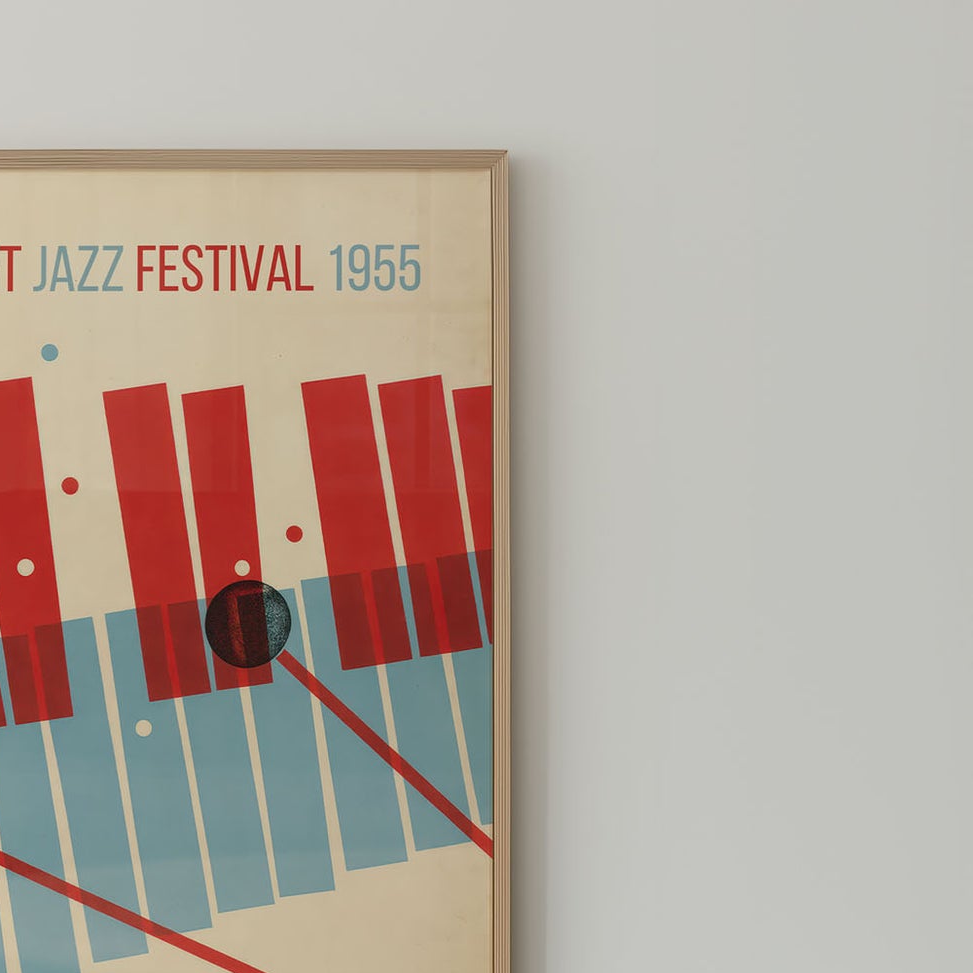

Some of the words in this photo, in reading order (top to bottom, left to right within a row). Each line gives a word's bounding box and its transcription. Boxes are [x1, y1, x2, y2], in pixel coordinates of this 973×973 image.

[32, 245, 124, 292] JAZZ
[136, 244, 315, 292] FESTIVAL
[329, 244, 422, 292] 1955
